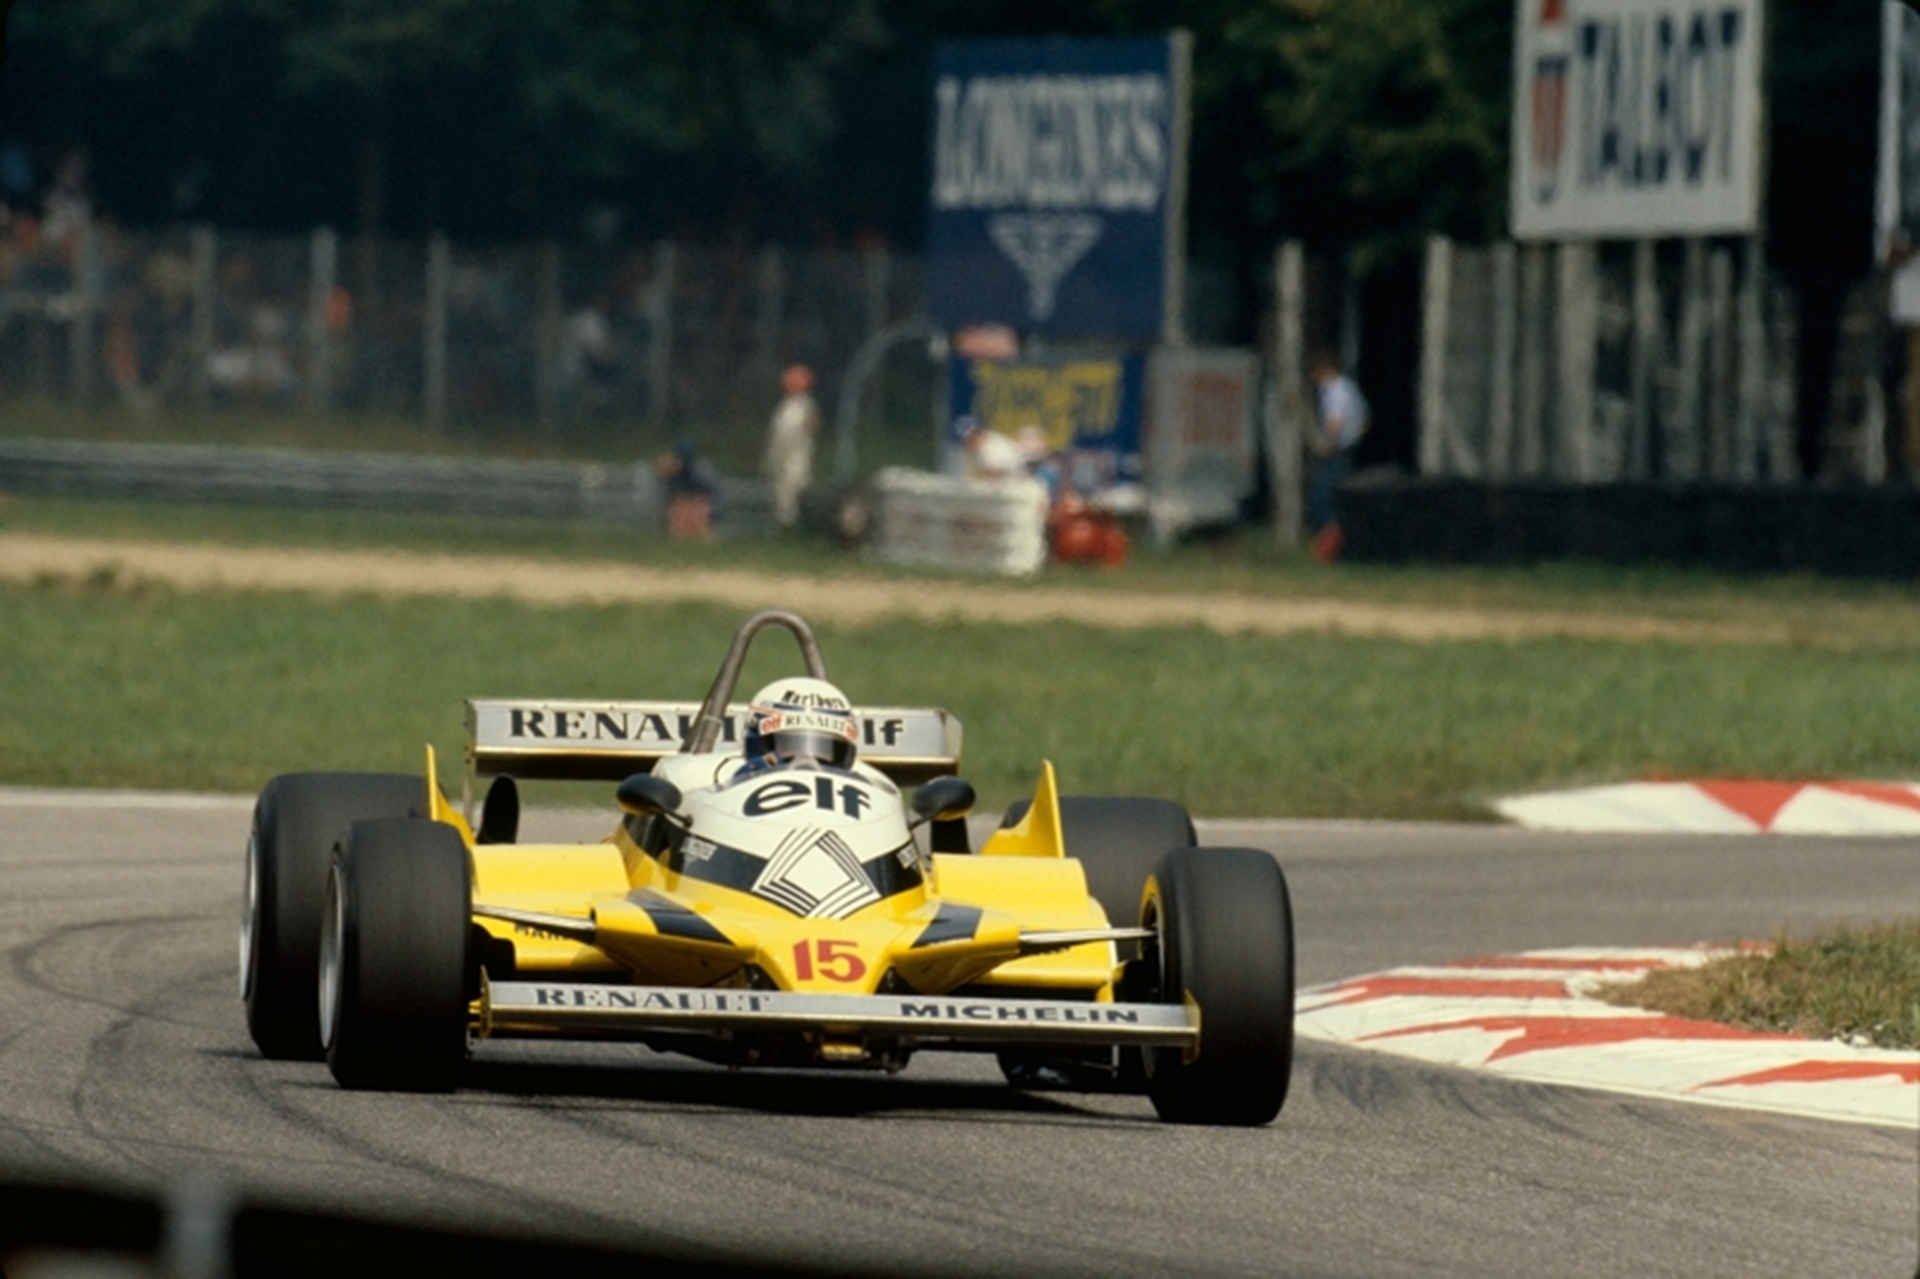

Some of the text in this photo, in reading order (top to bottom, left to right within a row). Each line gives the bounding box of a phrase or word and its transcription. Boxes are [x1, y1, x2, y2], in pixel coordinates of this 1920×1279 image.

[863, 719, 904, 746] lf
[743, 776, 871, 820] elf
[793, 939, 867, 983] 15
[536, 988, 770, 1012] RENAULT
[901, 1003, 1139, 1023] MICHELIN
